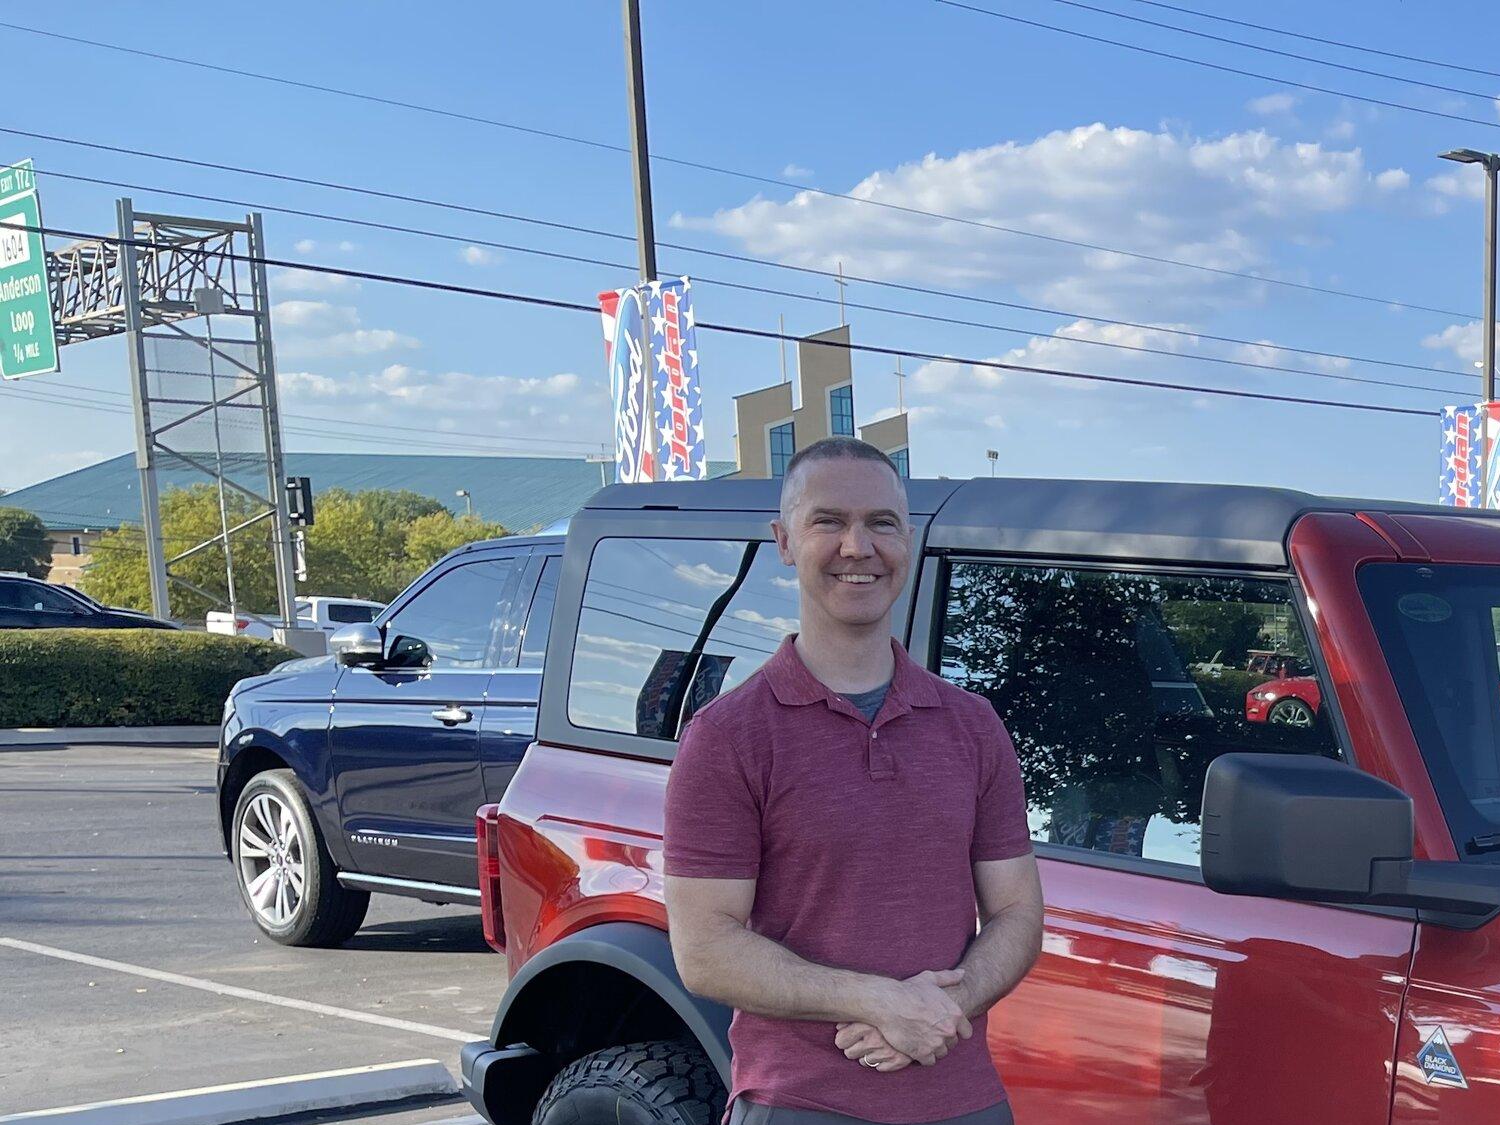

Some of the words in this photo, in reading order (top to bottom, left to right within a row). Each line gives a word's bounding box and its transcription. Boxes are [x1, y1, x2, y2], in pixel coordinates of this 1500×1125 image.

[15, 166, 31, 190] 172
[1, 233, 25, 262] 1604
[10, 310, 34, 335] Loop
[25, 342, 40, 358] MILE
[662, 291, 690, 474] Jordan
[1424, 1055, 1447, 1065] BLACK
[1424, 1061, 1456, 1074] DIAMOND
